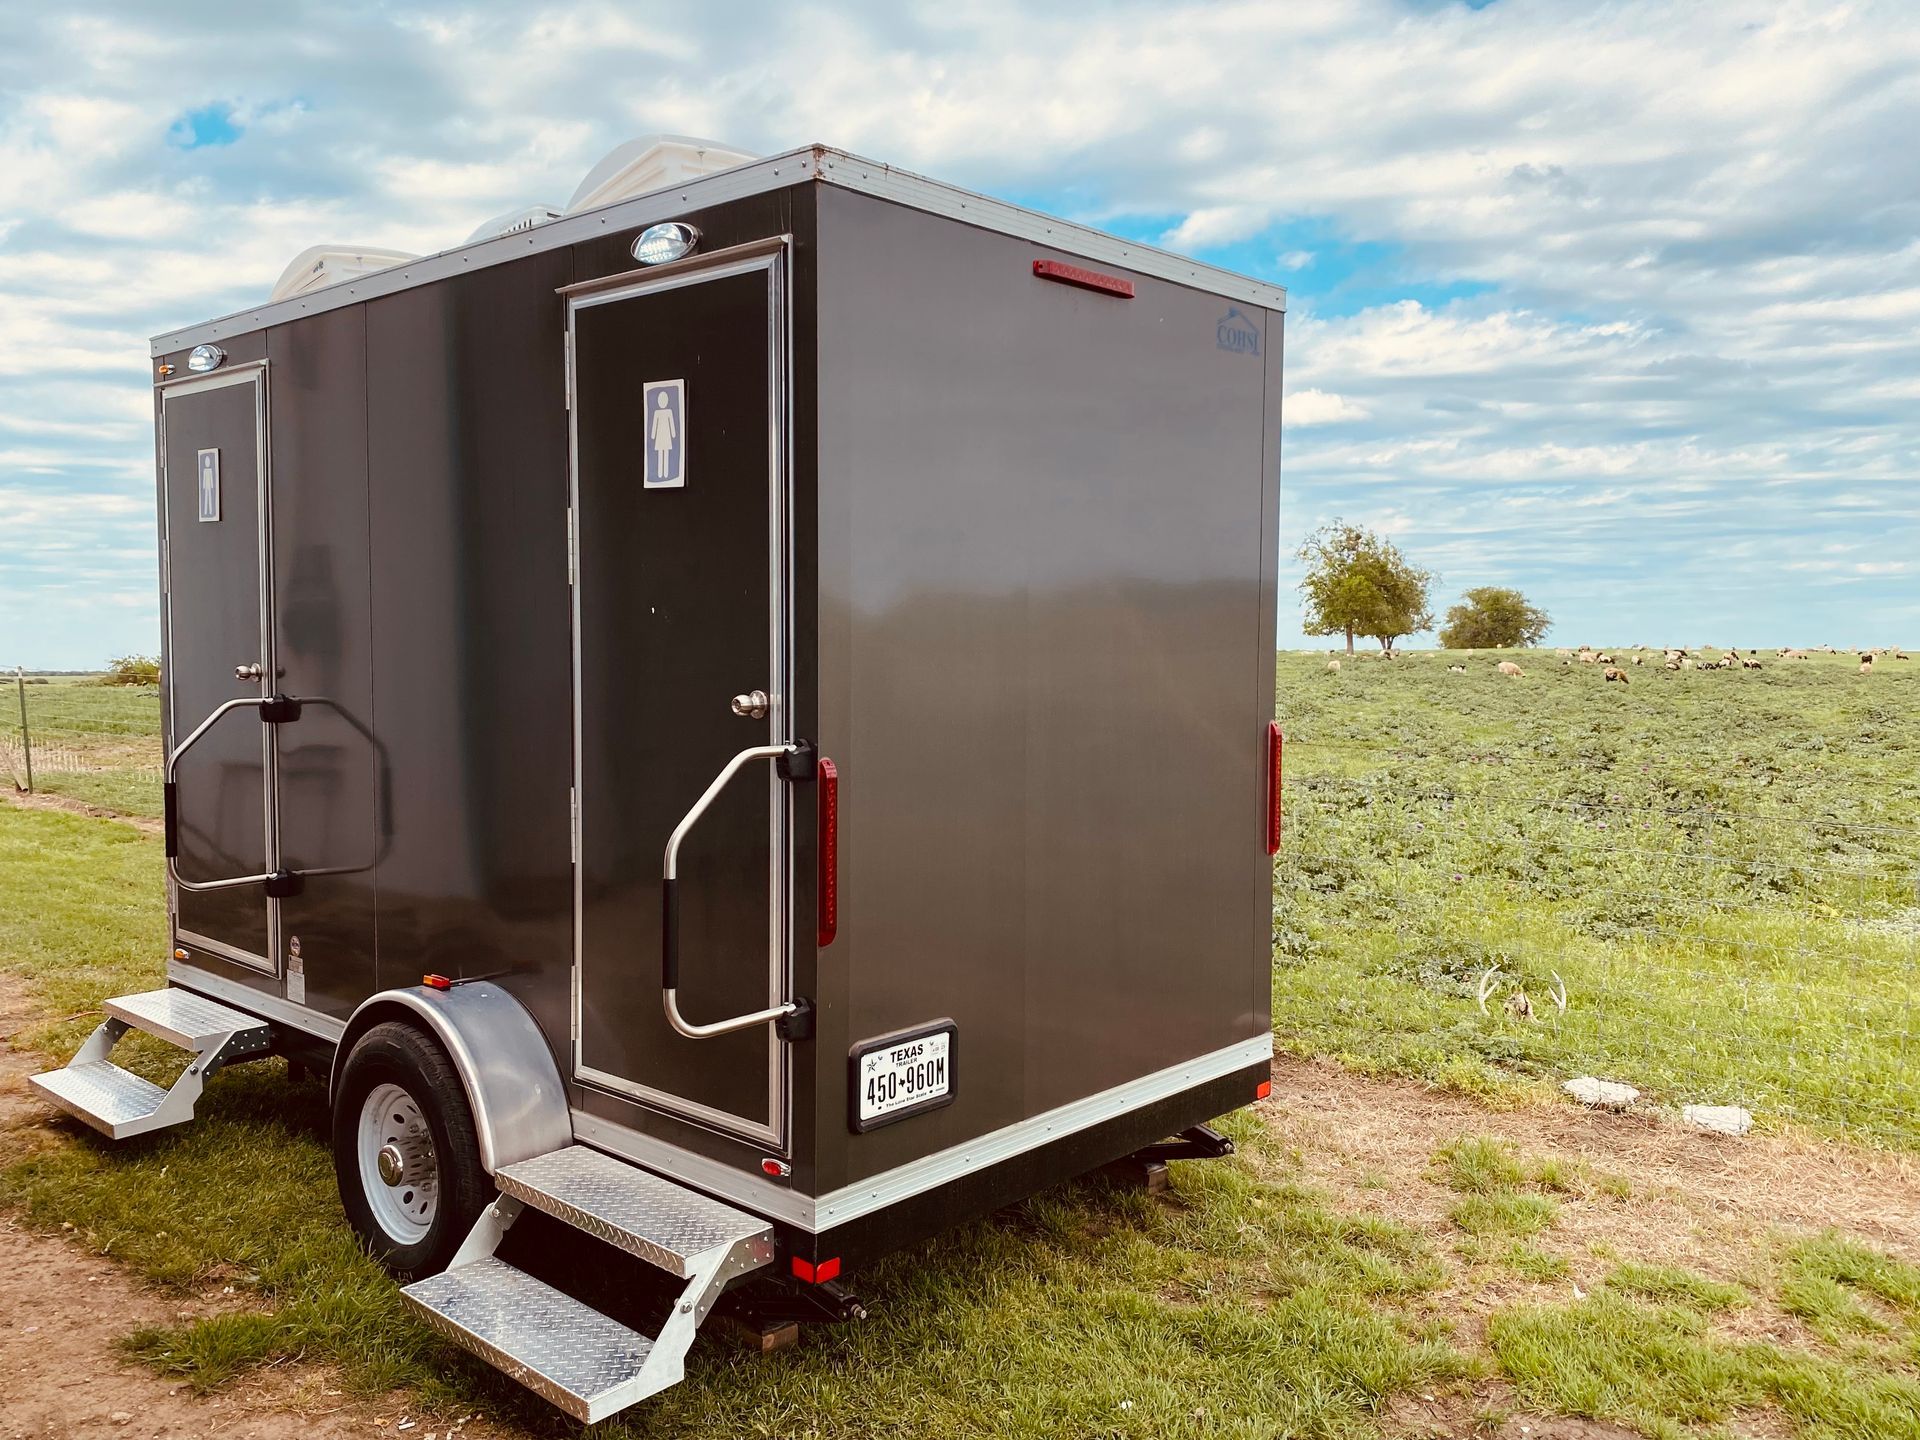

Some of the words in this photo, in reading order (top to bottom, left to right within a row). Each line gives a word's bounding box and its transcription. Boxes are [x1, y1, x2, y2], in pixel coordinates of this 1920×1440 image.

[890, 1044, 923, 1062] TEXAS
[896, 1057, 918, 1068] TRAILER
[867, 1072, 896, 1105] 450
[906, 1057, 944, 1093] 960M
